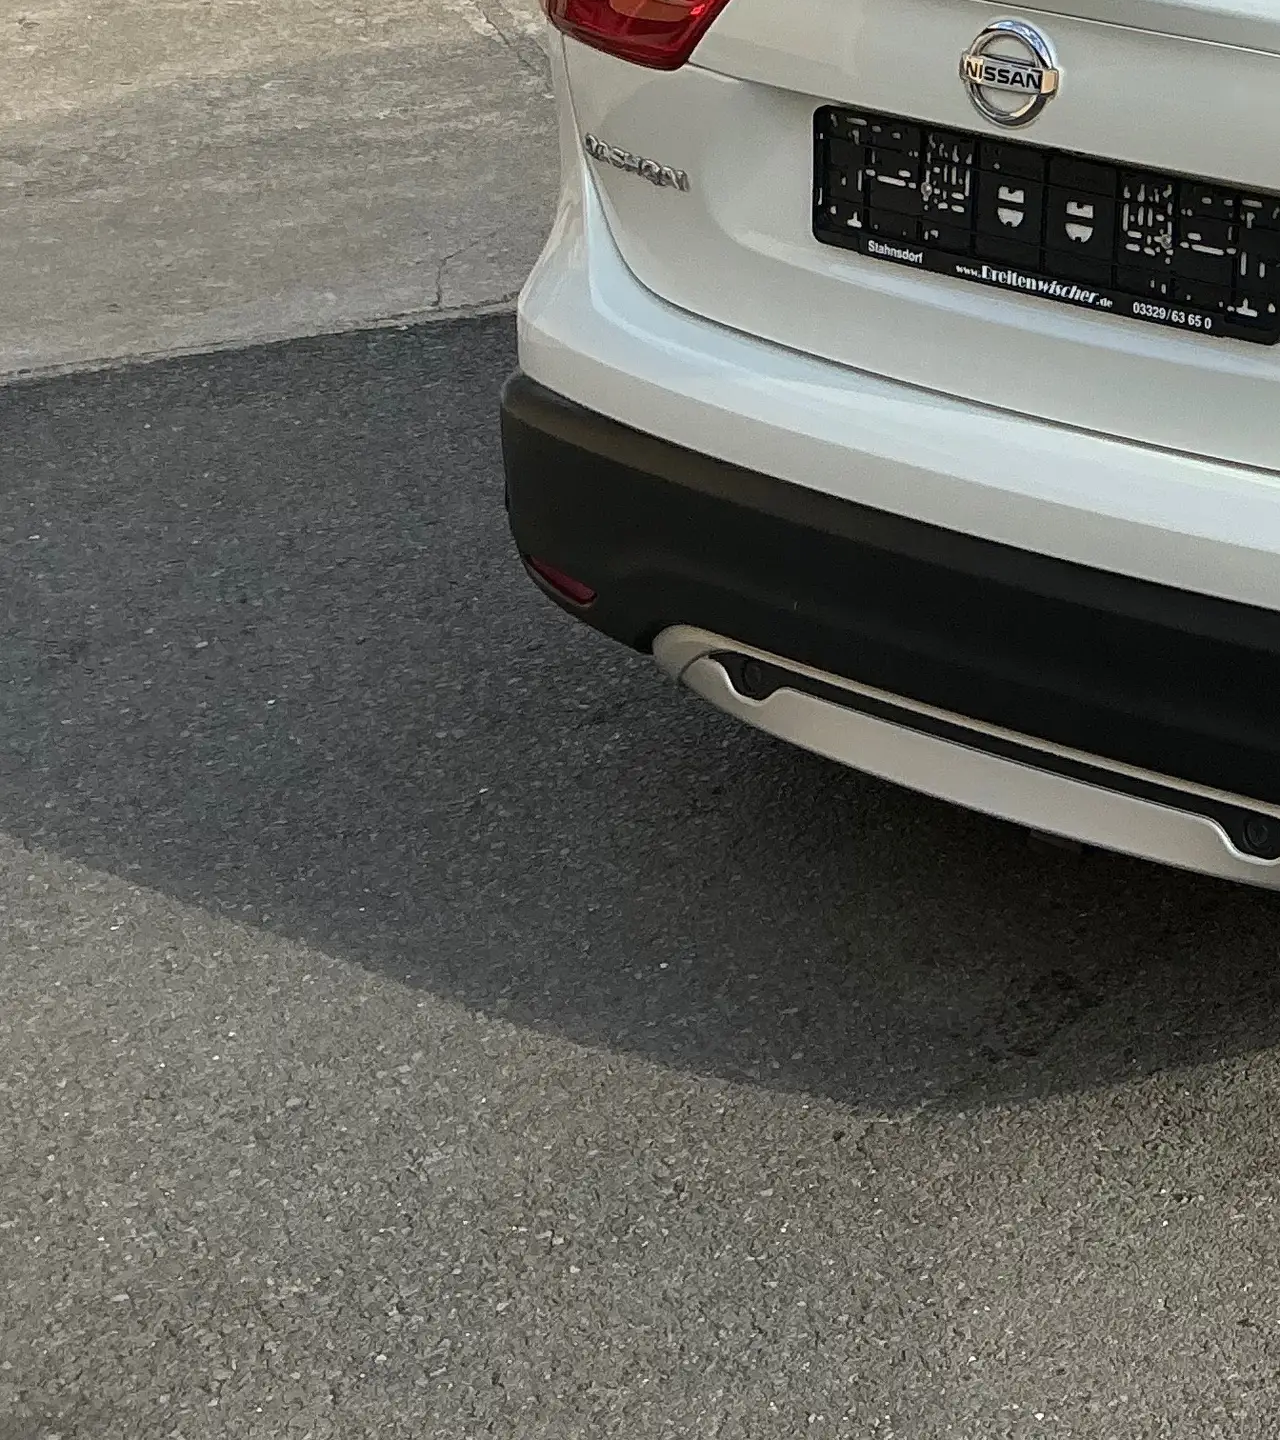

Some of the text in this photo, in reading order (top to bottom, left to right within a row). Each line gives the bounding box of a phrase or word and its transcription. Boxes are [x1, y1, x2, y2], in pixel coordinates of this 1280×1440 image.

[965, 60, 1042, 89] NISSAN
[868, 240, 923, 264] Stahnsdorf
[956, 265, 1113, 308] www.Breitenwischer.de
[1132, 301, 1212, 330] 03329/63 65 0
